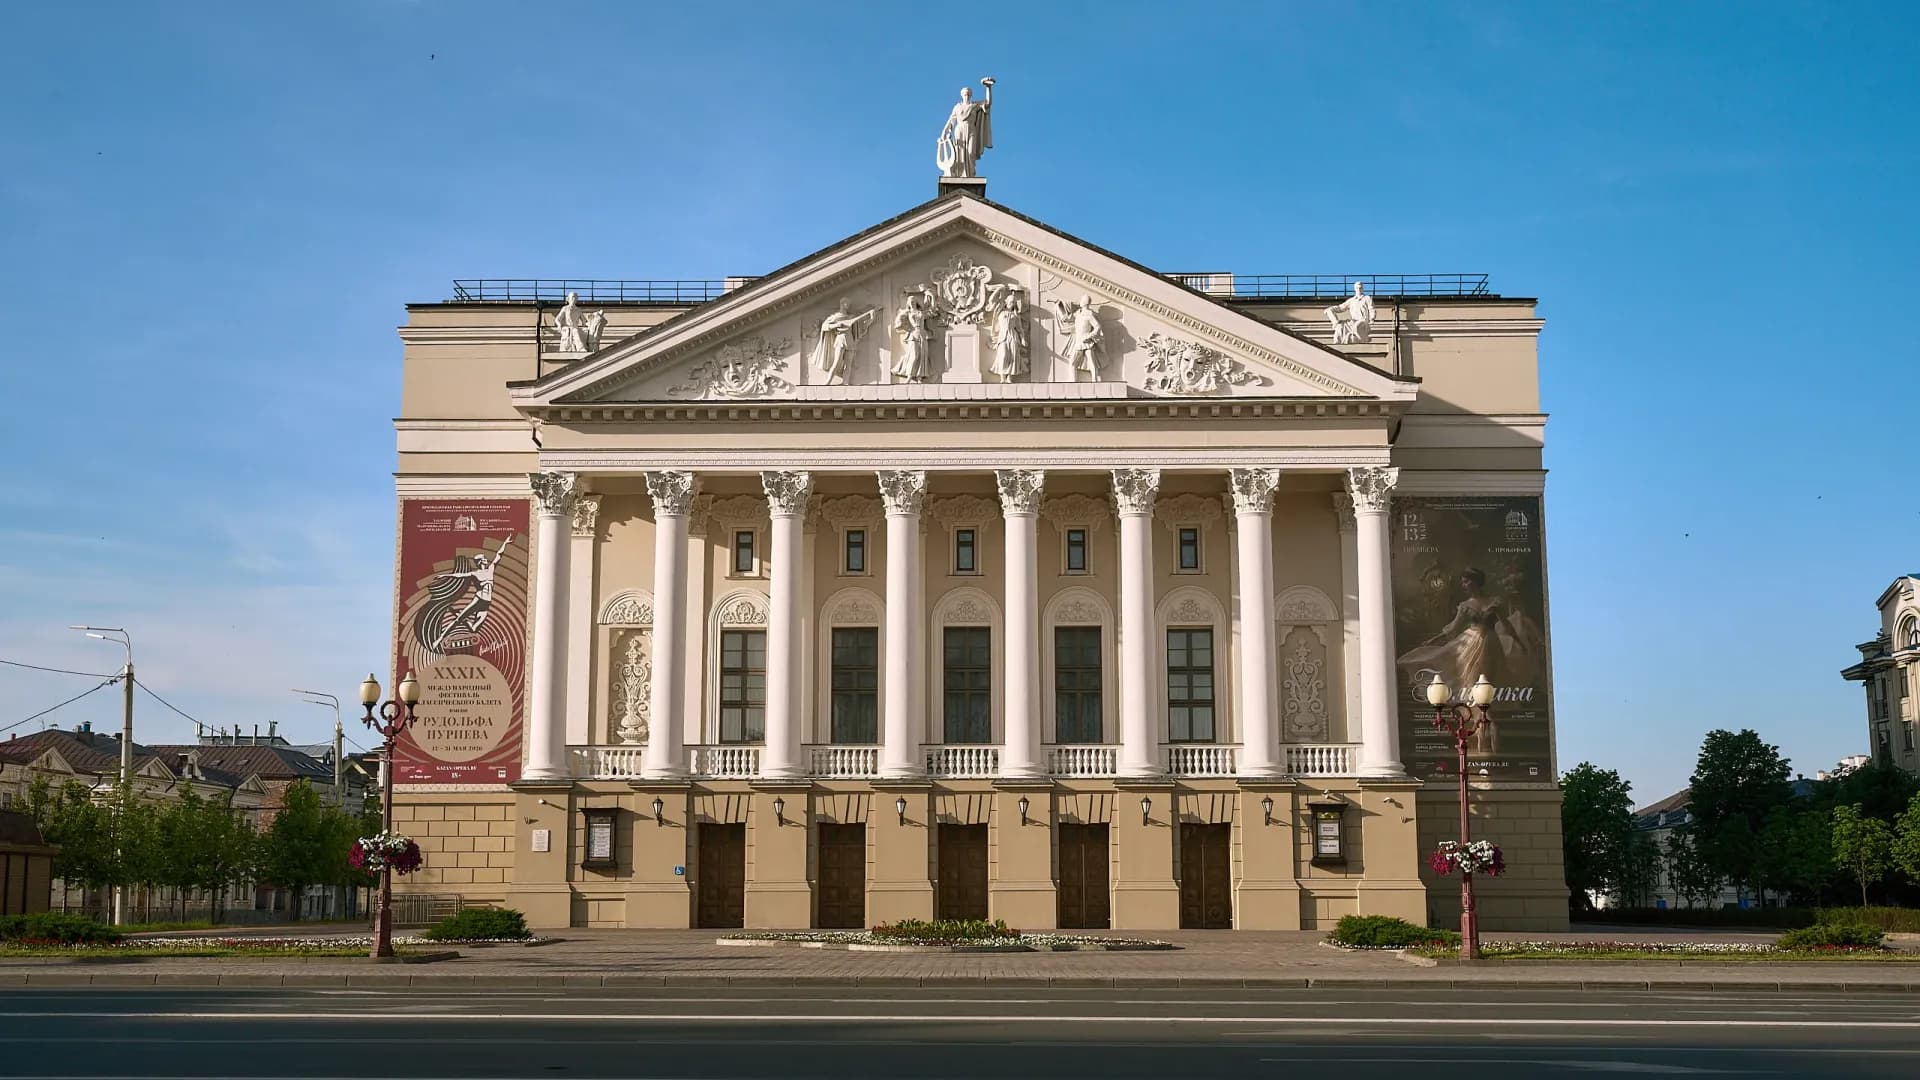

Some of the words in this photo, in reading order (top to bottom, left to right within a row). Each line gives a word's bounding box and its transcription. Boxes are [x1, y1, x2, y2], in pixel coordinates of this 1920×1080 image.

[1403, 528, 1419, 541] 13
[434, 666, 487, 680] XXXIX
[1411, 668, 1535, 707] Злушка
[423, 716, 494, 728] РУДОЛЬФА
[427, 729, 489, 740] НУРИЕВА
